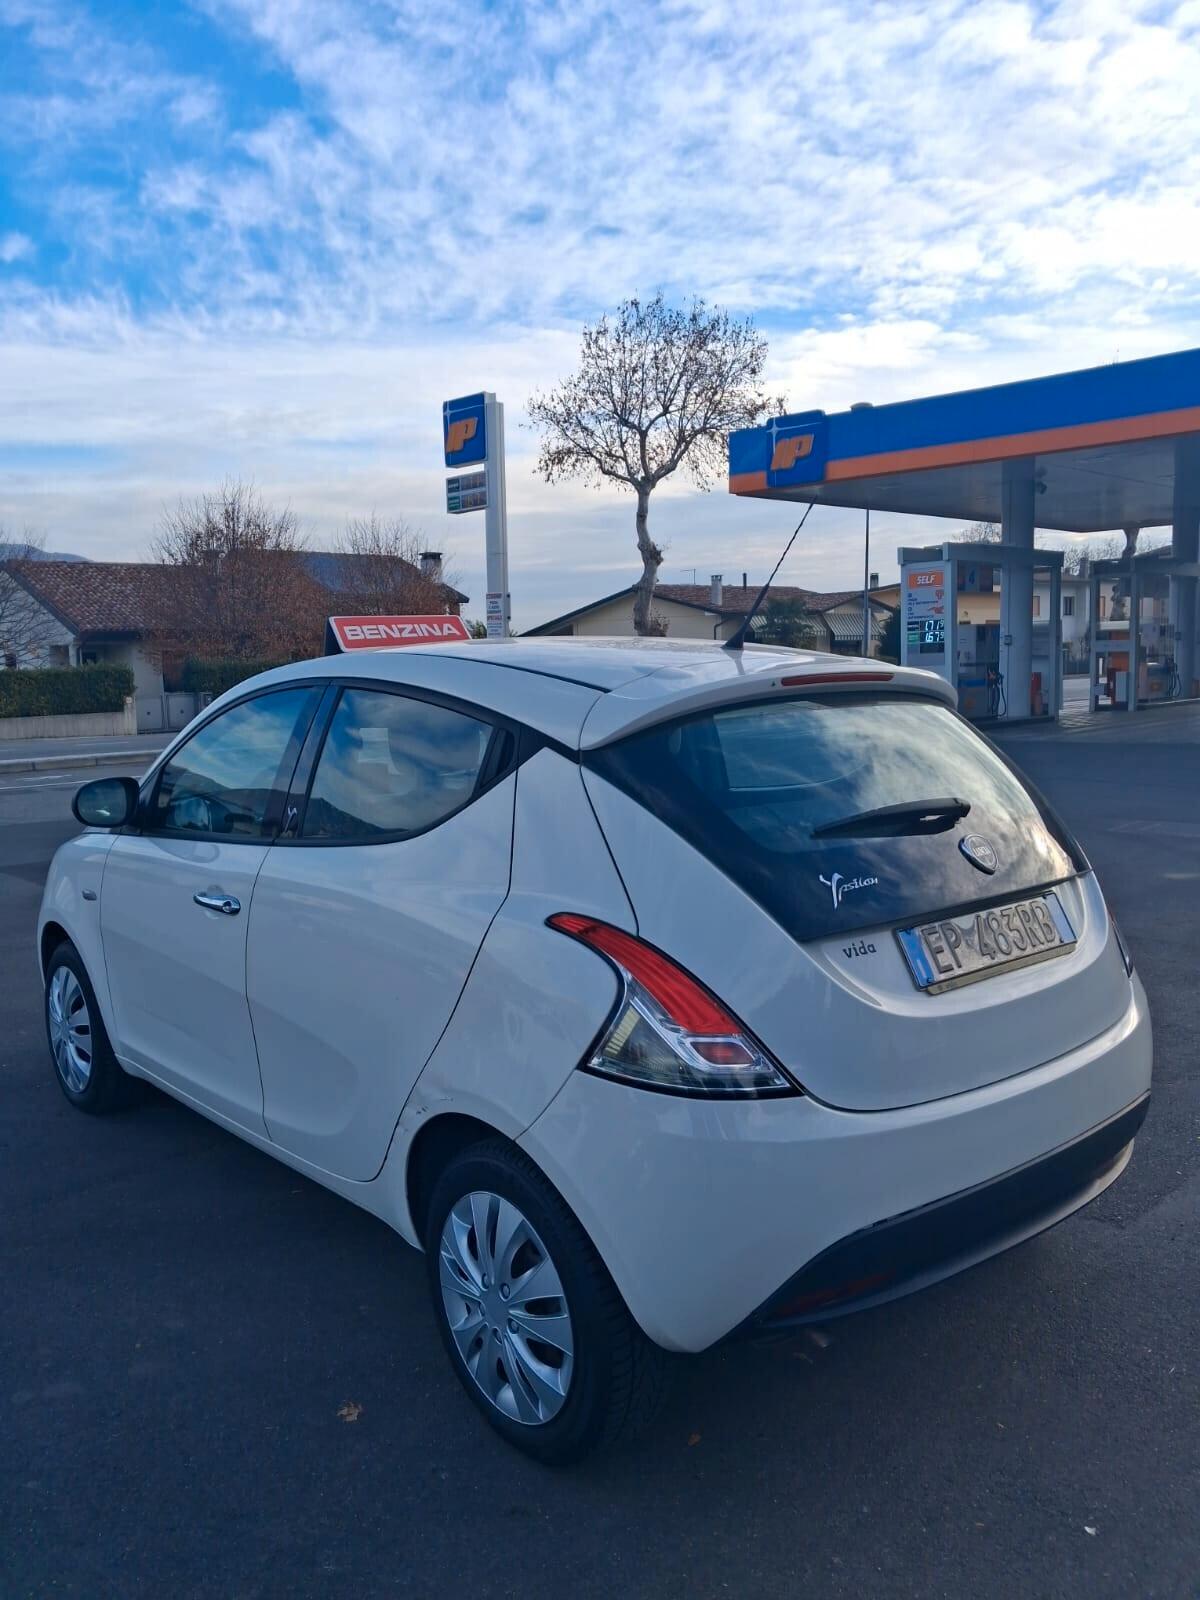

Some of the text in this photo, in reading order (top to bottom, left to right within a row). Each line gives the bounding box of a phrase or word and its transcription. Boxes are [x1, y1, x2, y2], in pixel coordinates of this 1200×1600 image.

[916, 574, 937, 585] SELF
[343, 623, 462, 640] BENZINA
[819, 873, 878, 910] Ypsilon
[920, 922, 962, 974] EP
[975, 901, 1056, 960] 483RB
[843, 940, 877, 959] vida
